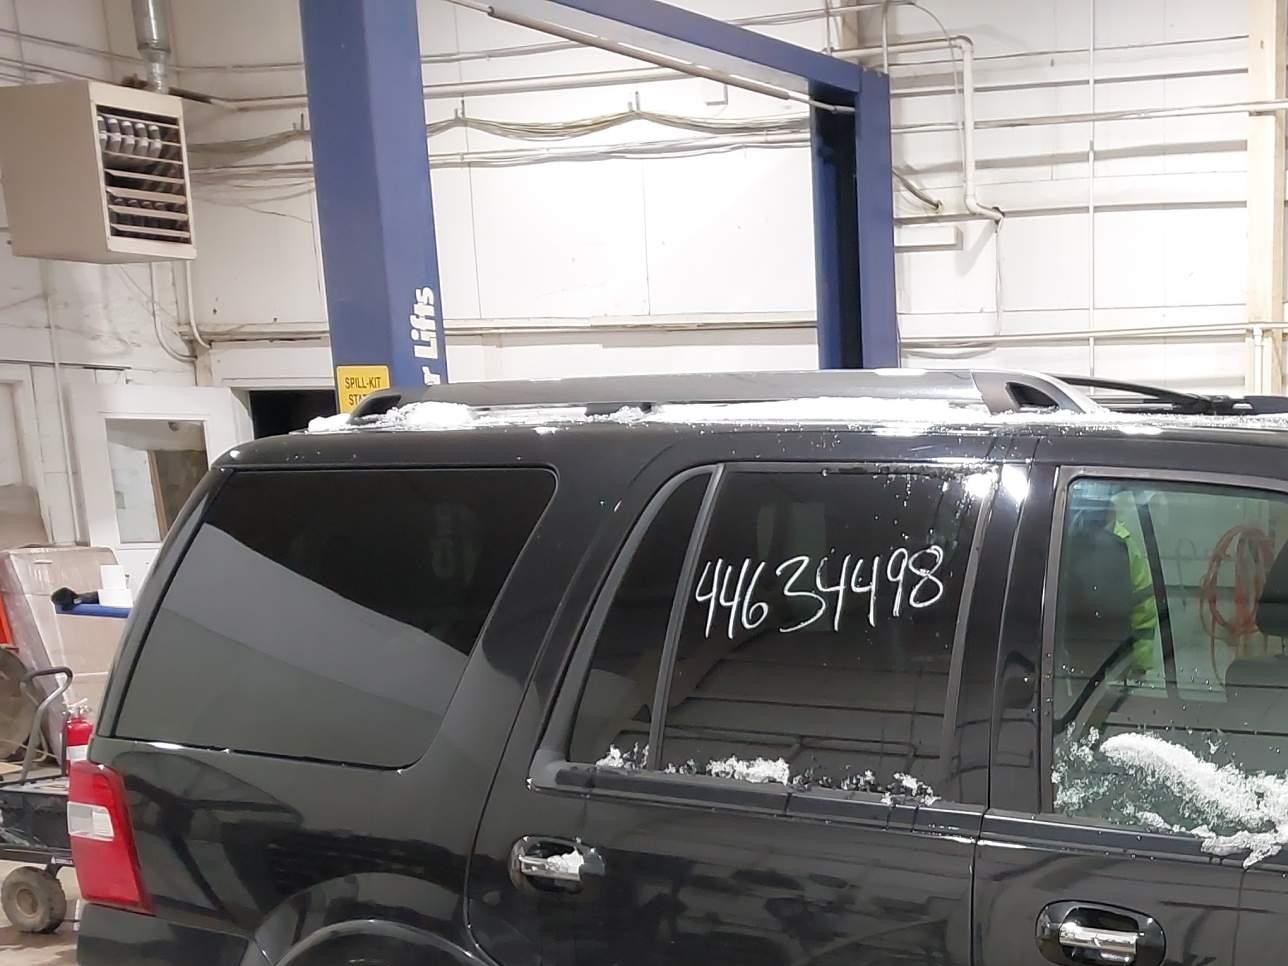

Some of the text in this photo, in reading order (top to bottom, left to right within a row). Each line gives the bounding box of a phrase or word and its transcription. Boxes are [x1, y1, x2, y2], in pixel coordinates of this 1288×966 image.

[410, 287, 438, 359] Lifts
[345, 376, 381, 389] SPILL-KIT
[696, 545, 943, 639] 44634498
